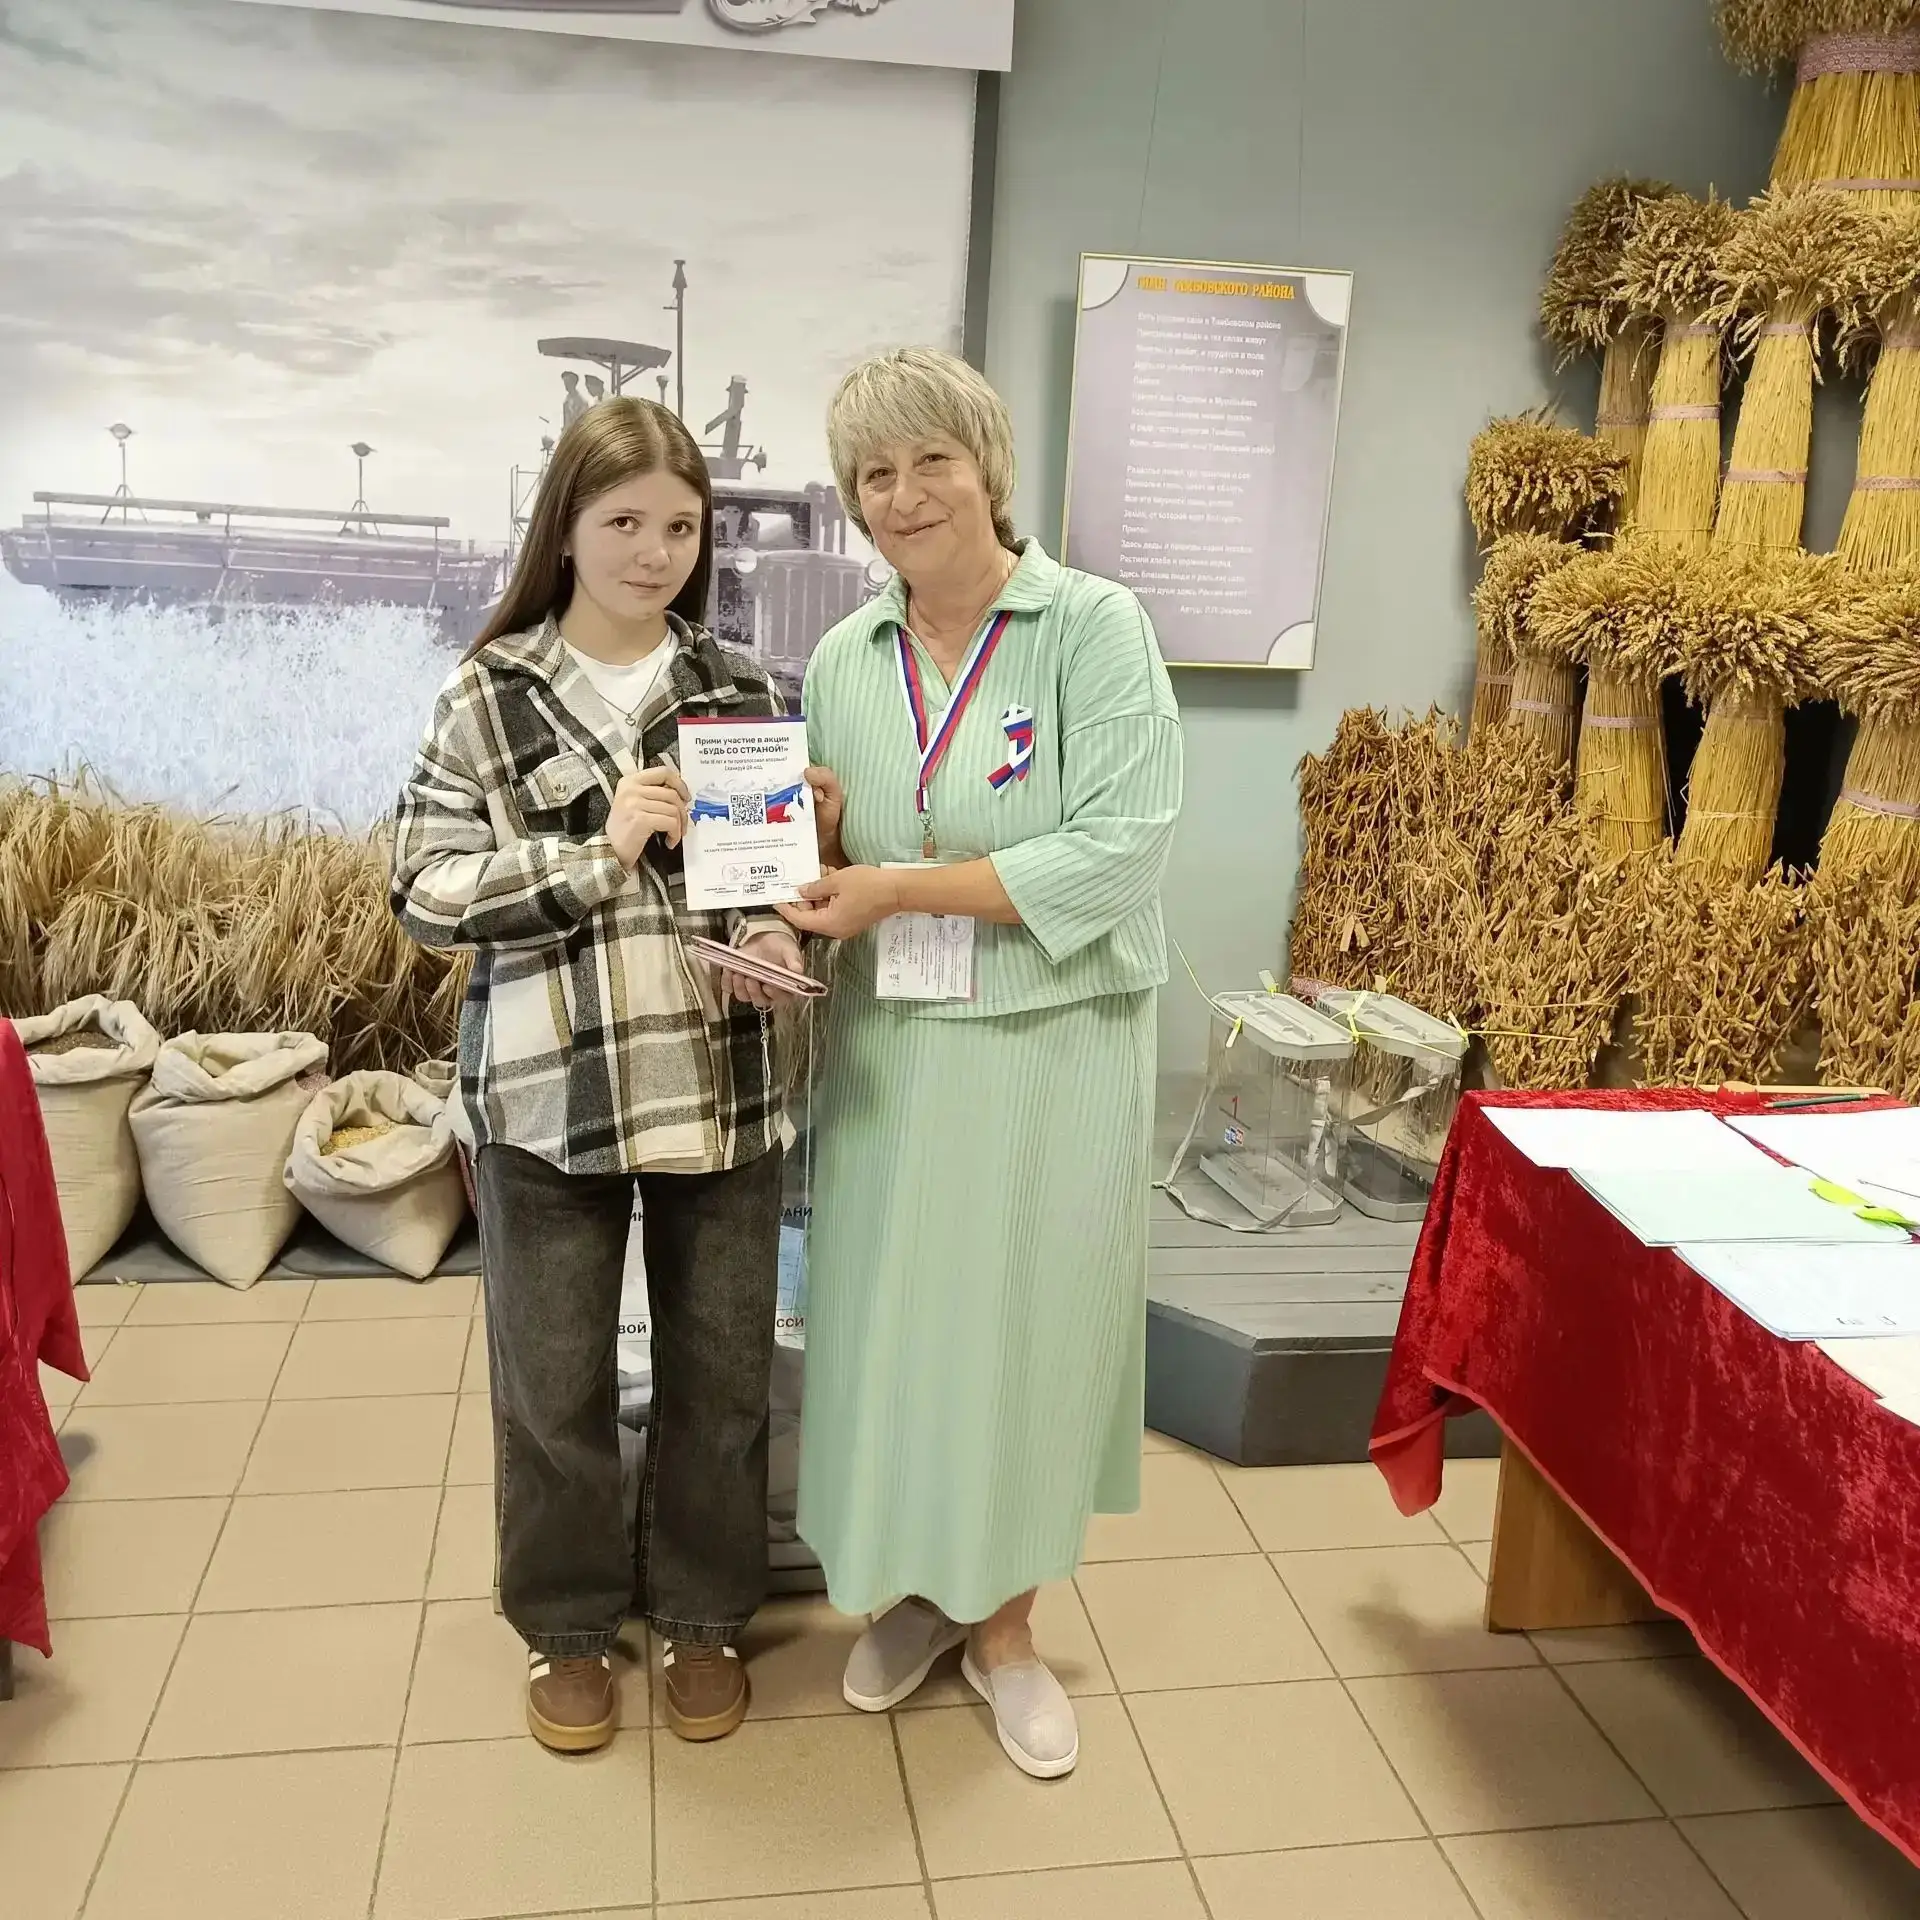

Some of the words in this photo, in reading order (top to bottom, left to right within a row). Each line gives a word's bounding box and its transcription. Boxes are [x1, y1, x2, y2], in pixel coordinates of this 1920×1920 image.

[1252, 281, 1295, 300] РАЙОНА
[695, 738, 722, 746] Прими
[723, 737, 756, 746] участие
[764, 736, 790, 744] акции
[698, 748, 725, 756] «БУДЬ
[740, 744, 789, 754] СТРАНОЙ!»
[750, 864, 778, 875] БУДЬ
